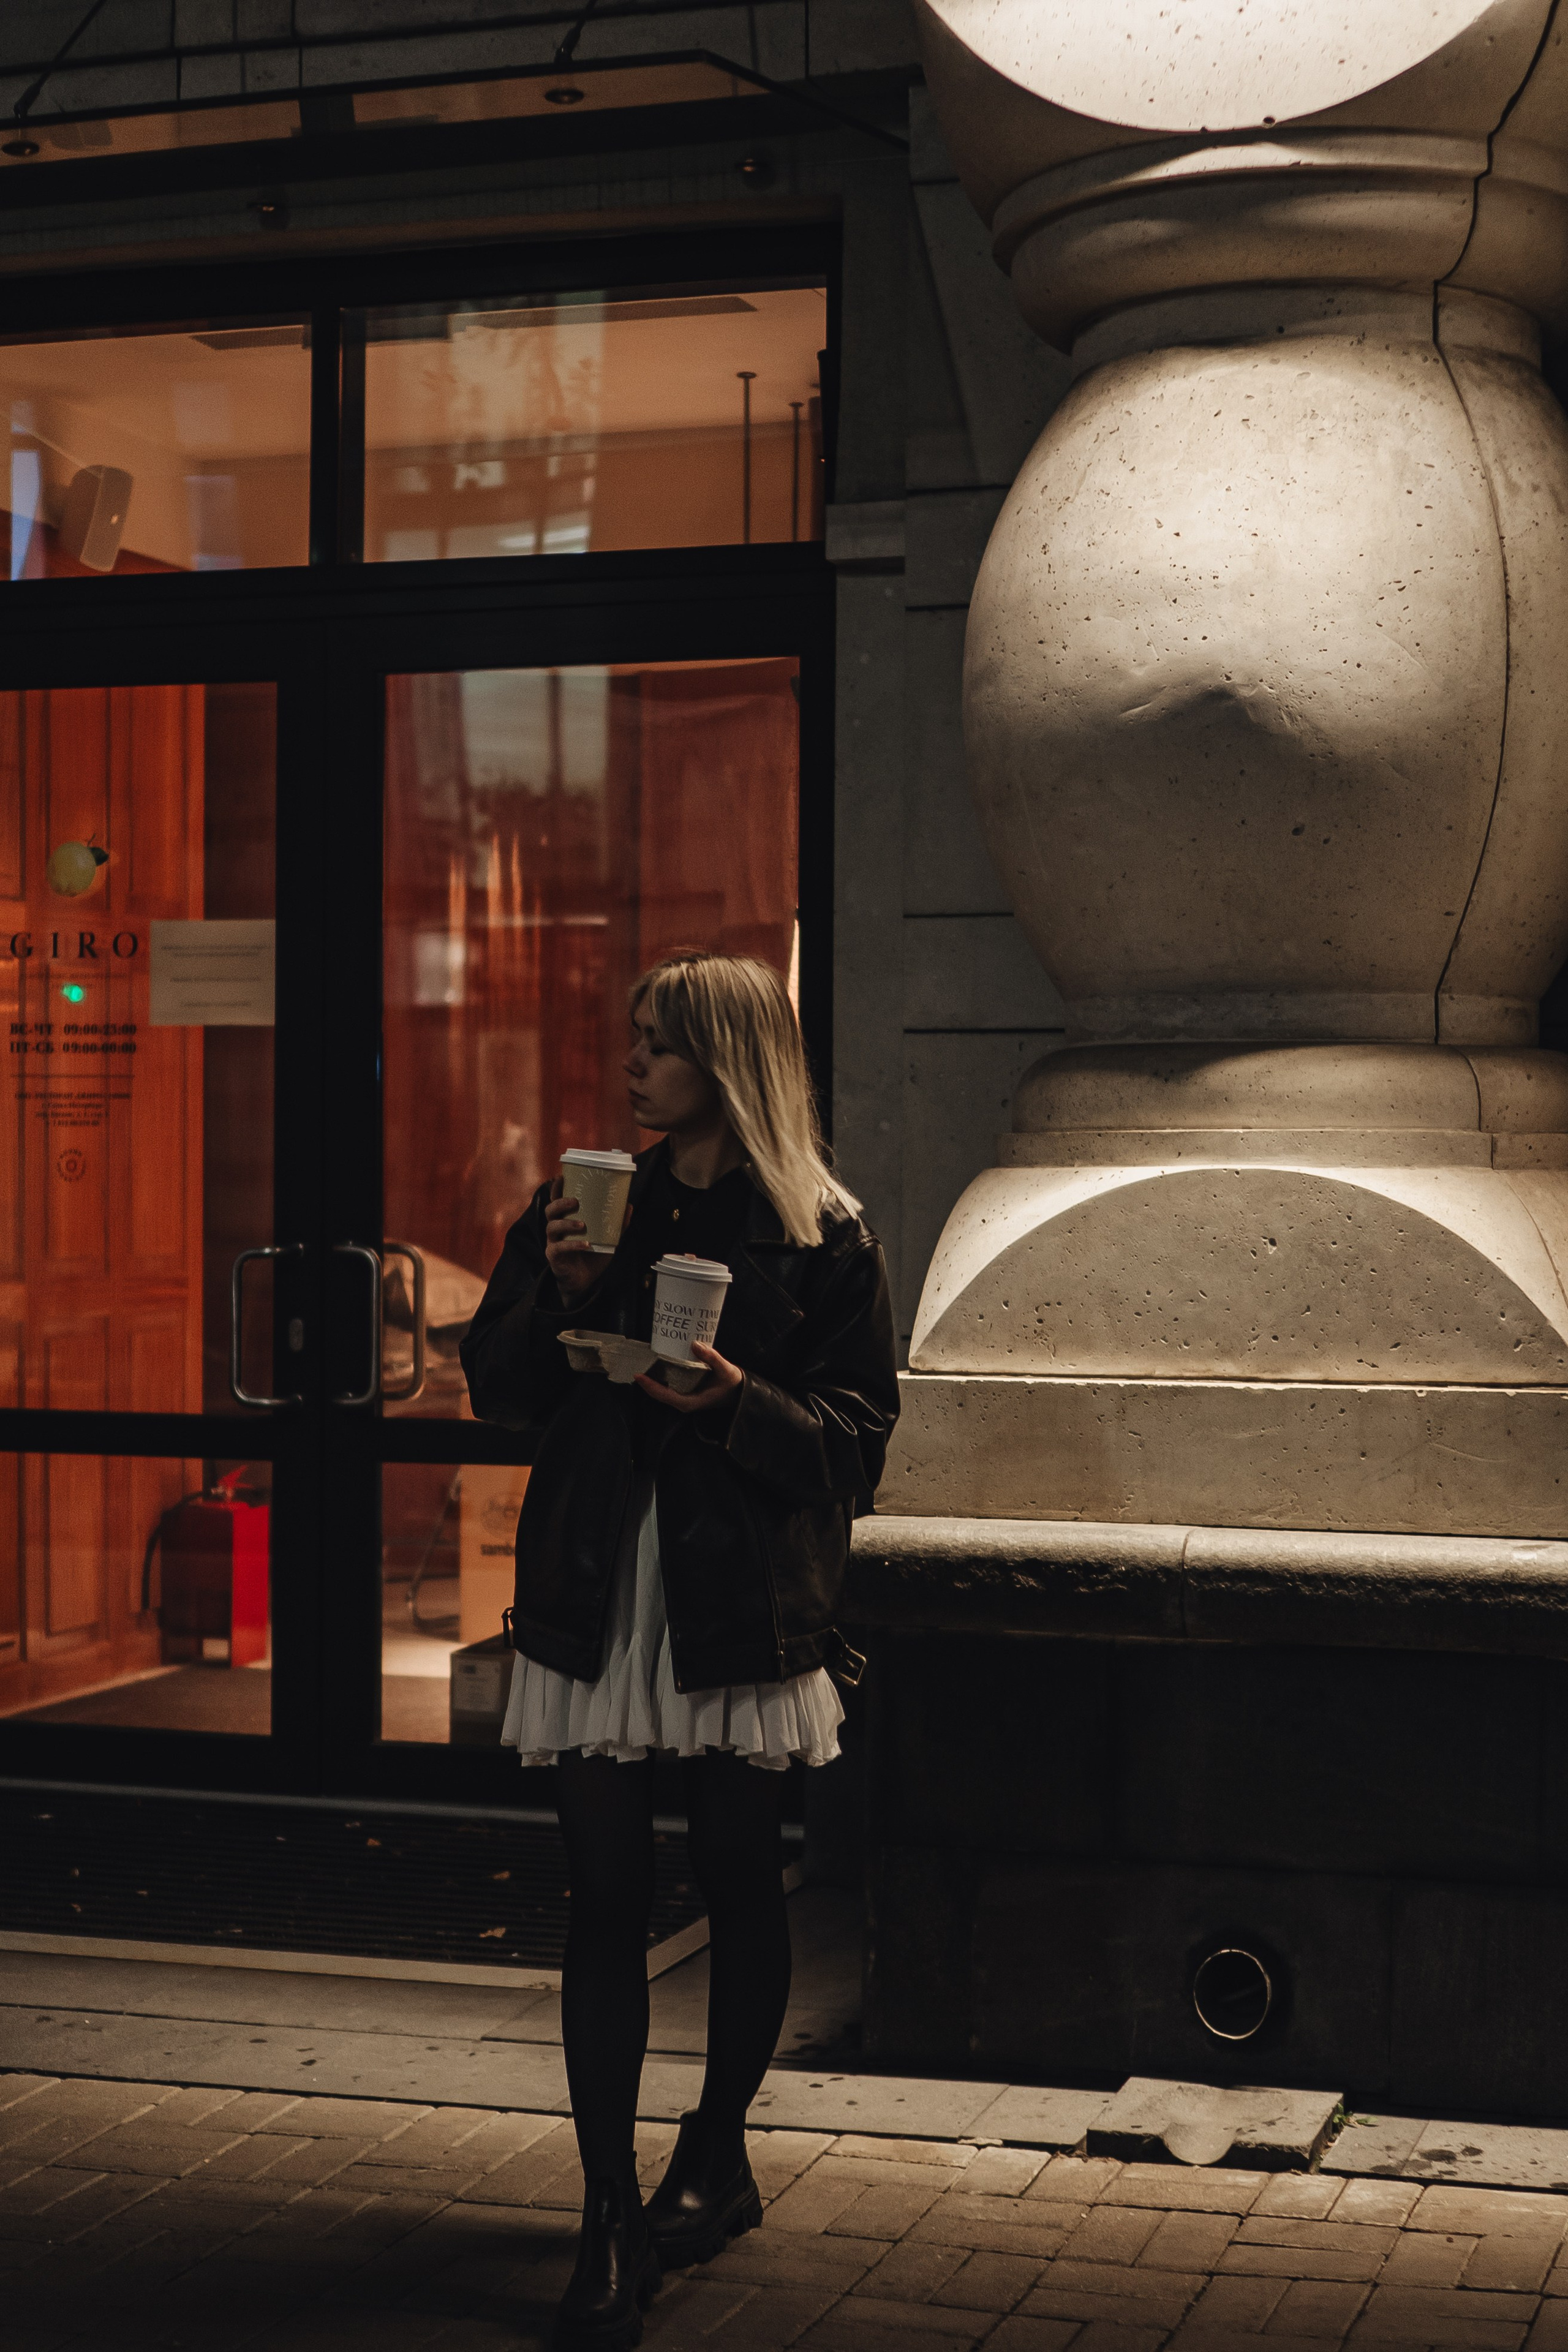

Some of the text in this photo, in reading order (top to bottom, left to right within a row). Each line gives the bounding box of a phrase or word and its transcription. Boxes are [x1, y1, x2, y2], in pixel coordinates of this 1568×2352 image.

[10, 931, 138, 959] GIRO
[663, 1302, 695, 1316] SLOW
[654, 1313, 691, 1330] OFFEE
[660, 1328, 690, 1341] SLOW
